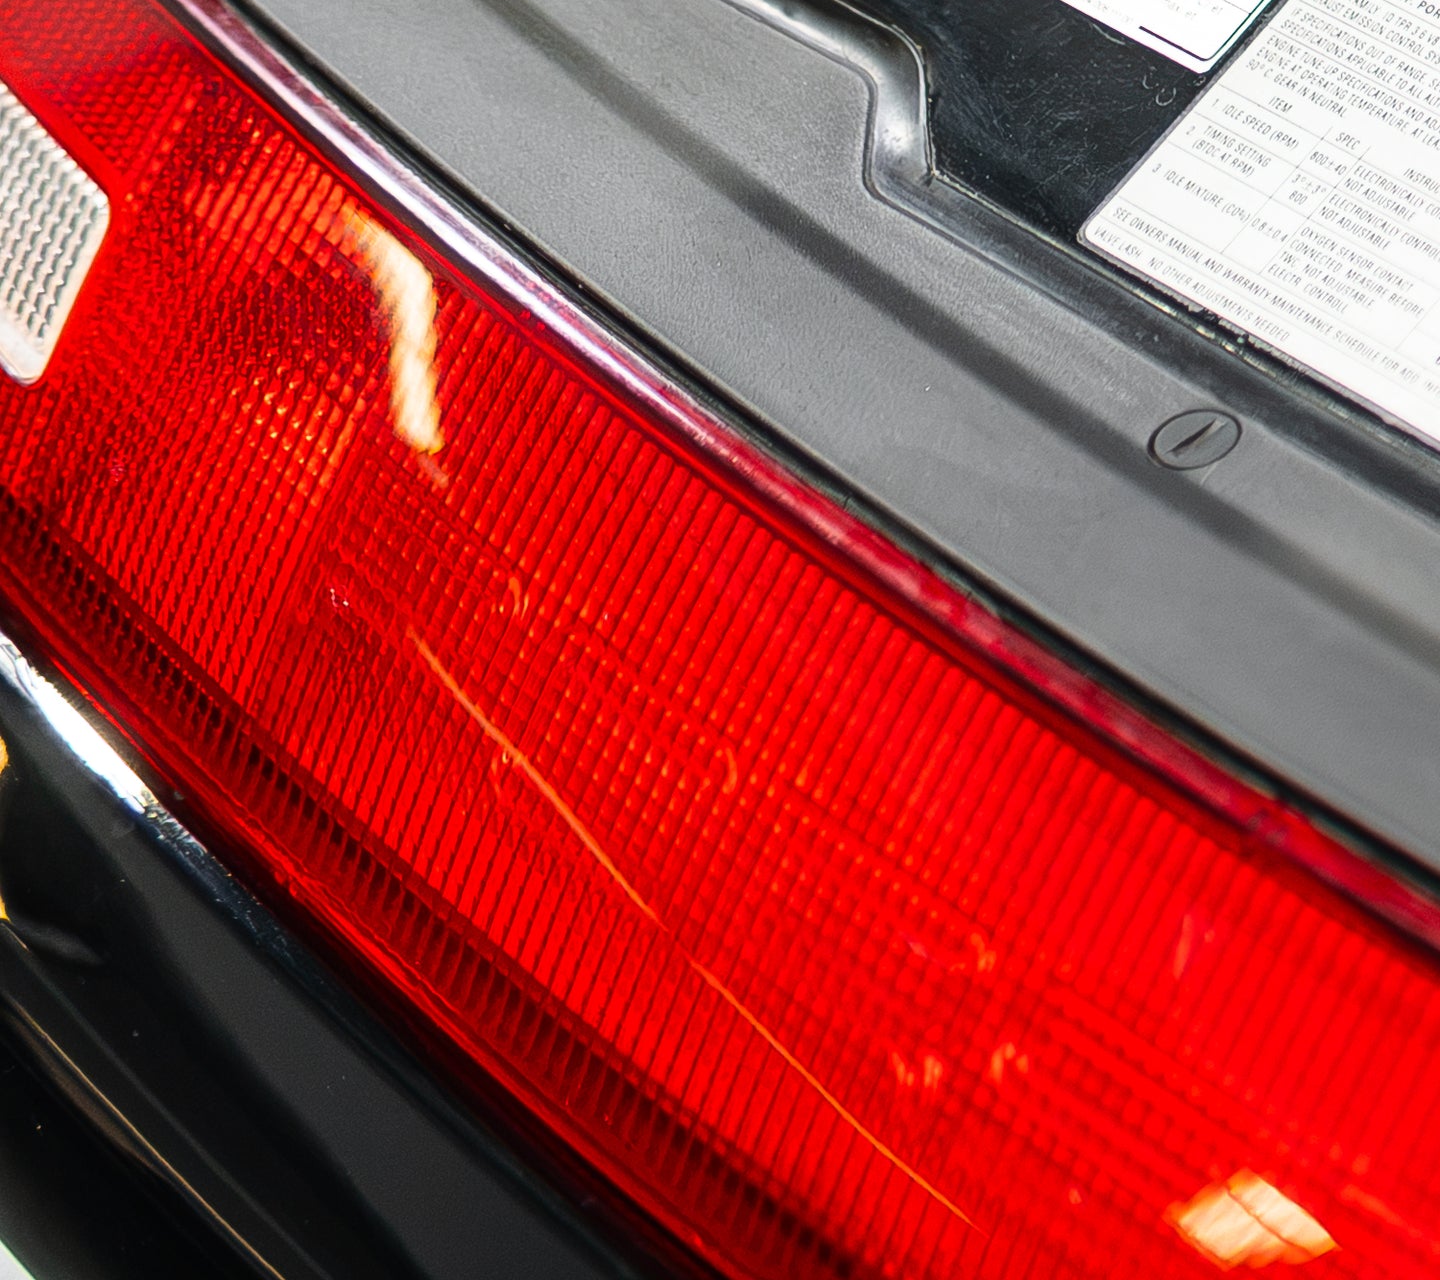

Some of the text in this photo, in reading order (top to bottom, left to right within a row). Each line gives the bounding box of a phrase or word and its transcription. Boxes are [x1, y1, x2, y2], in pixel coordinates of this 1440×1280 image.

[1288, 6, 1303, 19] IF
[1297, 11, 1368, 52] SPECIFICATIONS
[1362, 44, 1385, 61] OUT
[1380, 53, 1398, 68] OF
[1340, 7, 1388, 37] EMISSION
[1382, 28, 1428, 57] CONTROL
[1264, 33, 1302, 59] ENGINE
[1296, 50, 1340, 79] TUNE-UP
[1334, 70, 1406, 113] SPECIFICATIONS
[1400, 104, 1426, 123] AND
[1278, 18, 1348, 59] SPECIFICATIONS
[1342, 51, 1397, 84] APPLICABLE
[1392, 76, 1409, 91] TO
[1404, 83, 1425, 99] ALL
[1254, 45, 1292, 71] ENGINE
[1287, 62, 1303, 76] AT
[1297, 68, 1350, 101] OPERATING
[1408, 126, 1425, 140] AT
[1266, 94, 1294, 114] ITEM
[1270, 71, 1300, 92] GEAR
[1294, 84, 1311, 98] IN
[1201, 124, 1273, 169] TIMING SETTING
[1220, 102, 1245, 121] IDLE
[1239, 113, 1273, 136] SPEED
[1267, 128, 1301, 152] (RPM)
[1333, 130, 1362, 151] SPEC
[1190, 136, 1257, 178] (BTDC AT RPM)
[1161, 168, 1186, 187] IDLE
[1181, 179, 1225, 208] MIXTURE
[1341, 176, 1417, 222] NOT ADJUSTABLE
[1351, 163, 1427, 209] ELECTRONICALLY
[1316, 205, 1392, 251] NOT ADJUSTABLE
[1326, 192, 1402, 238] ELECTRONICALLY
[1298, 225, 1415, 294] OXYGEN SENSOR CONTACT
[1300, 262, 1323, 281] NOT
[1091, 225, 1122, 247] VALVE
[1145, 256, 1165, 272] NO
[1159, 264, 1194, 288] OTHER
[1188, 280, 1255, 323] ADJUSTMENTS
[1250, 314, 1291, 343] NEEDED
[1110, 206, 1133, 223] SEE
[1127, 215, 1169, 244] OWNERS
[1164, 236, 1206, 265] MANUAL
[1200, 256, 1225, 275] AND
[1329, 328, 1381, 364] SCHEDULE
[1376, 355, 1401, 374] FOR
[1342, 267, 1390, 299] MEASURE
[1385, 291, 1425, 319] BEFORE
